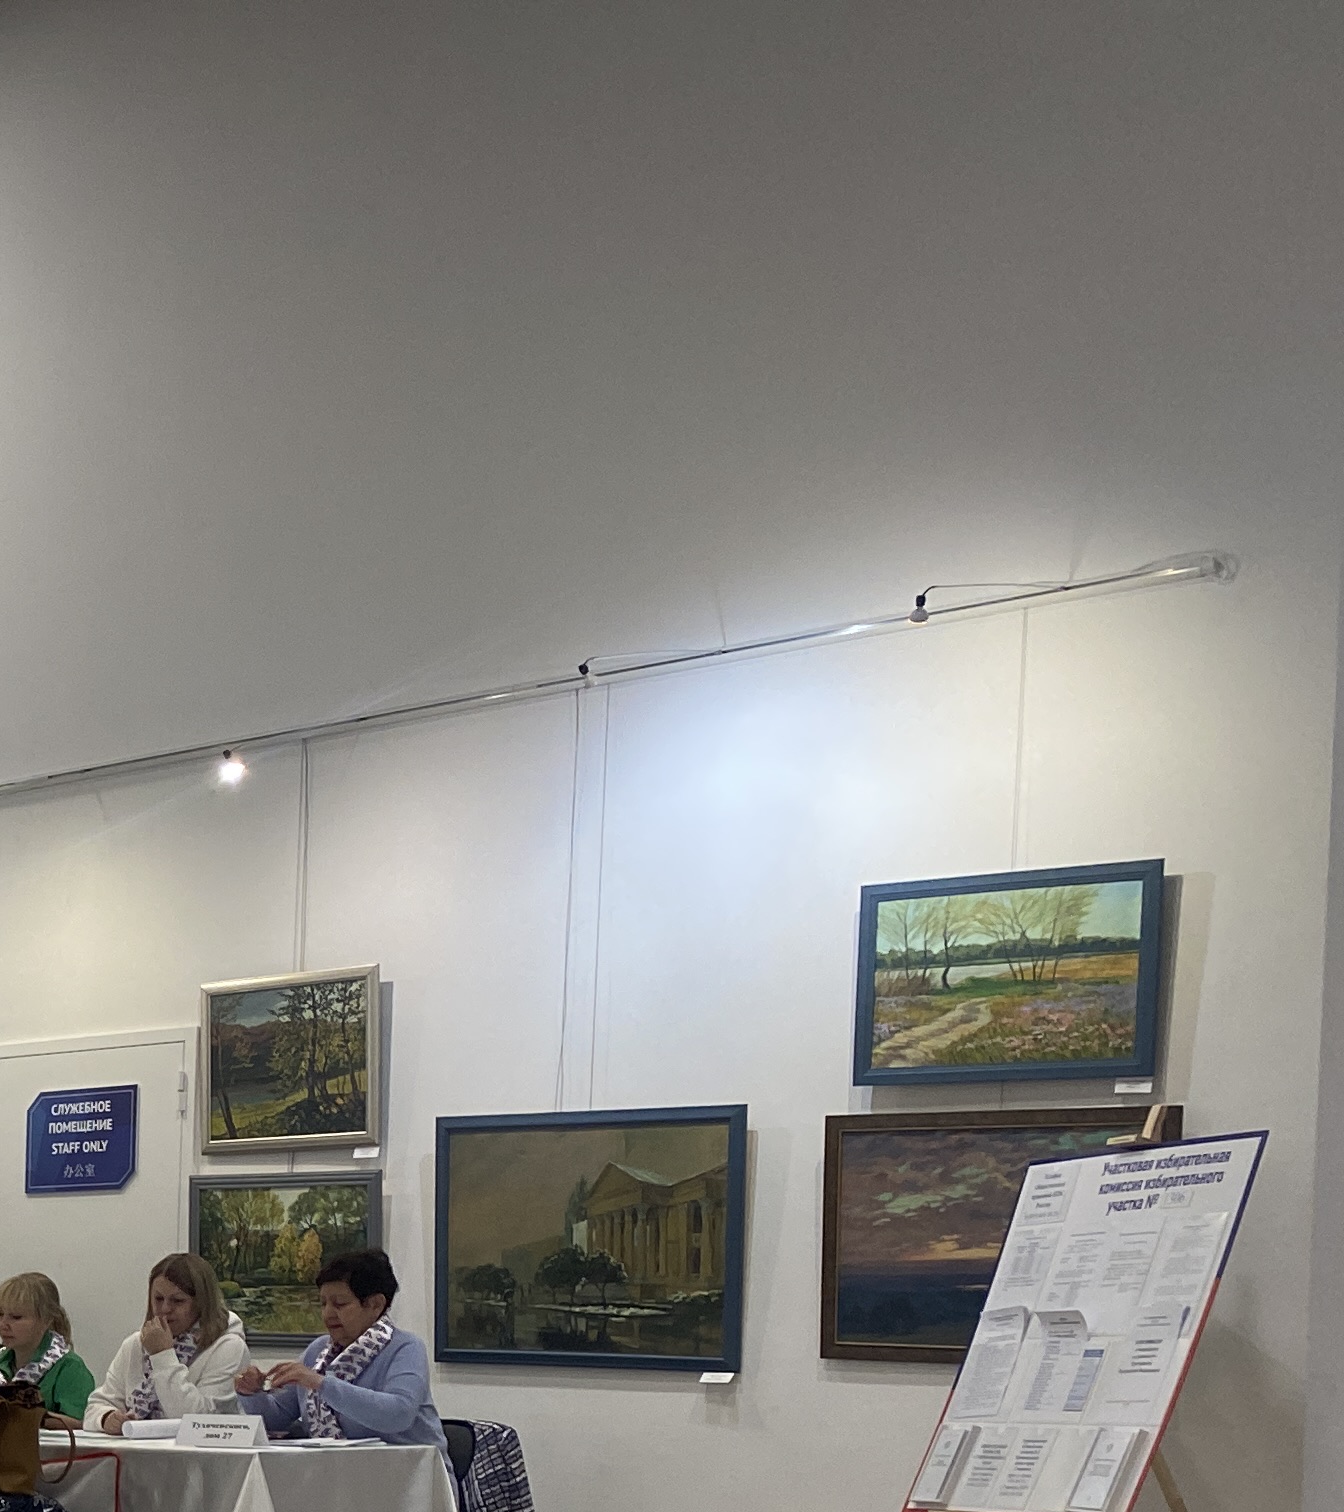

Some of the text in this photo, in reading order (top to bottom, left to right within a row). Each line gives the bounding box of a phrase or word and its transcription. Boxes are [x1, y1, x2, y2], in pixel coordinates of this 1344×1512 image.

[51, 1100, 112, 1116] СЛУЖЕБНОЕ
[48, 1118, 113, 1134] ПОМЕЩЕНИЕ
[51, 1140, 109, 1155] STAFF ONLY
[1101, 1159, 1154, 1176] Участковая
[1154, 1151, 1232, 1171] избирательная
[1098, 1171, 1225, 1195] комиссия избирательного
[1105, 1198, 1144, 1216] участка
[222, 1432, 233, 1440] 27
